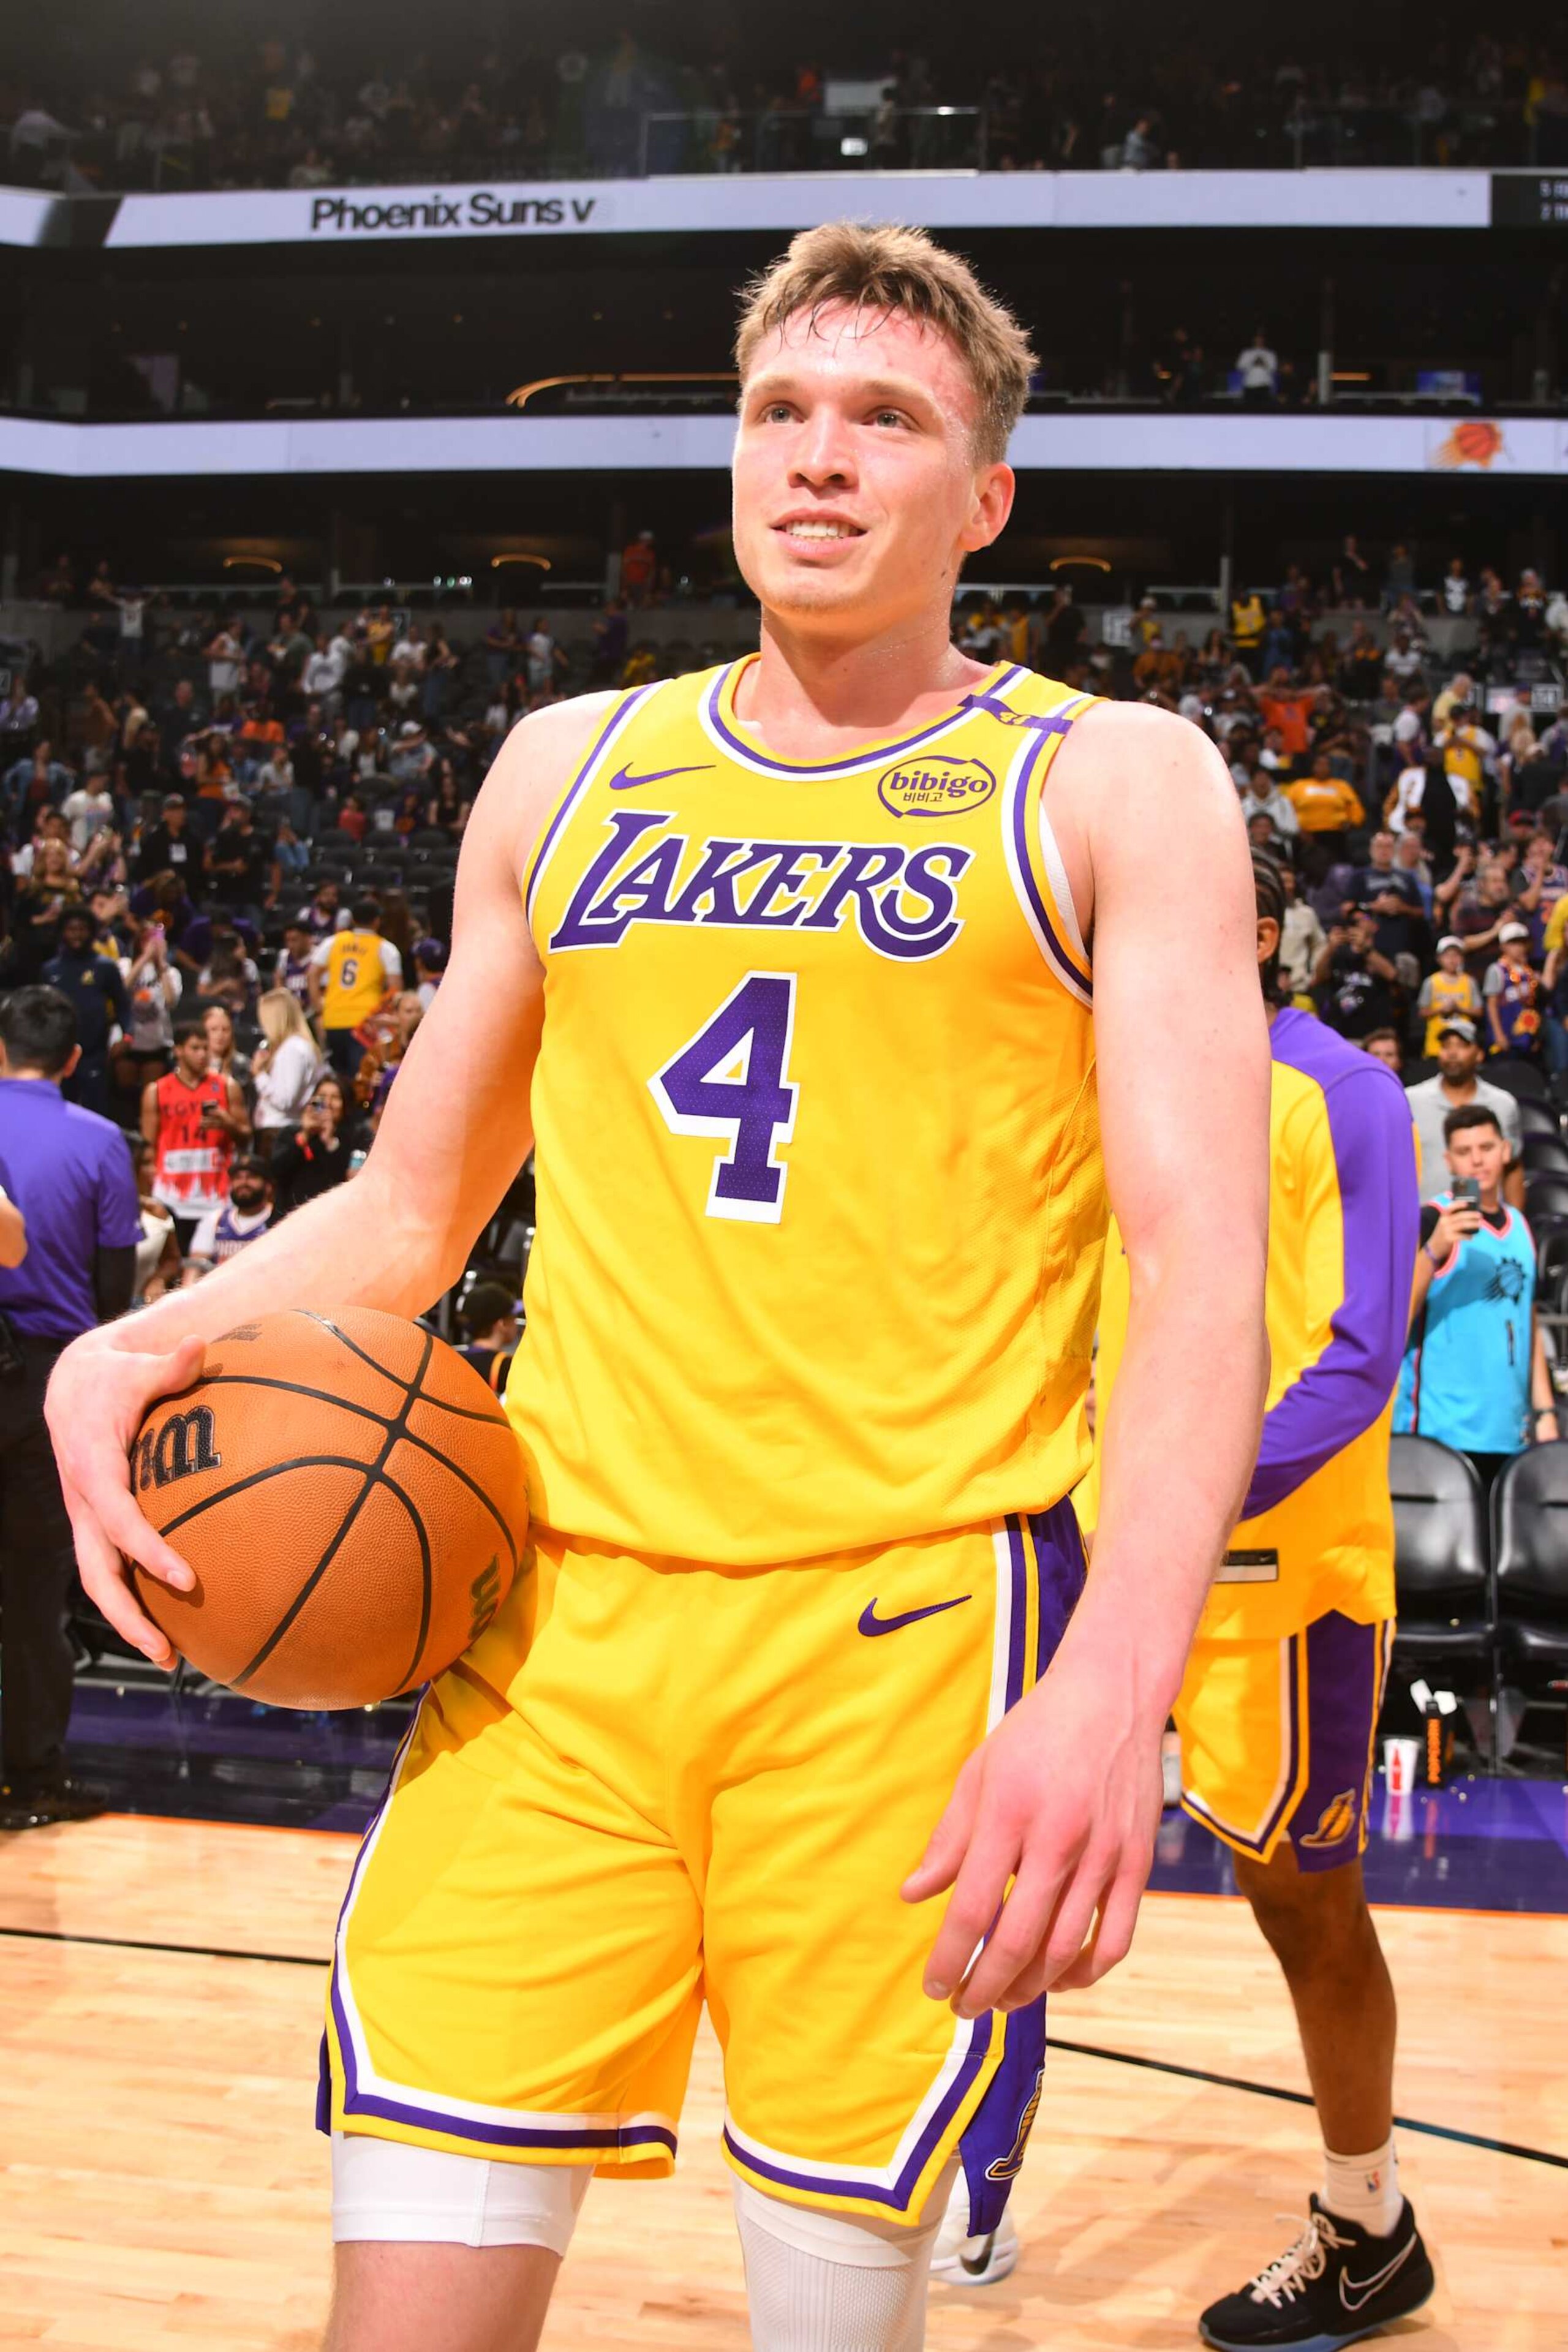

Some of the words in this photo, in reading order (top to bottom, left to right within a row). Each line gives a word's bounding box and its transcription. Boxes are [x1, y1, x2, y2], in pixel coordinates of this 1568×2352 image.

[311, 194, 461, 230] Phoenix
[468, 192, 564, 225] Suns
[889, 771, 989, 798] bibigo
[903, 792, 943, 803] 비비고
[548, 808, 977, 962] LAKERS
[341, 957, 358, 989] 6
[647, 970, 800, 1224] 4
